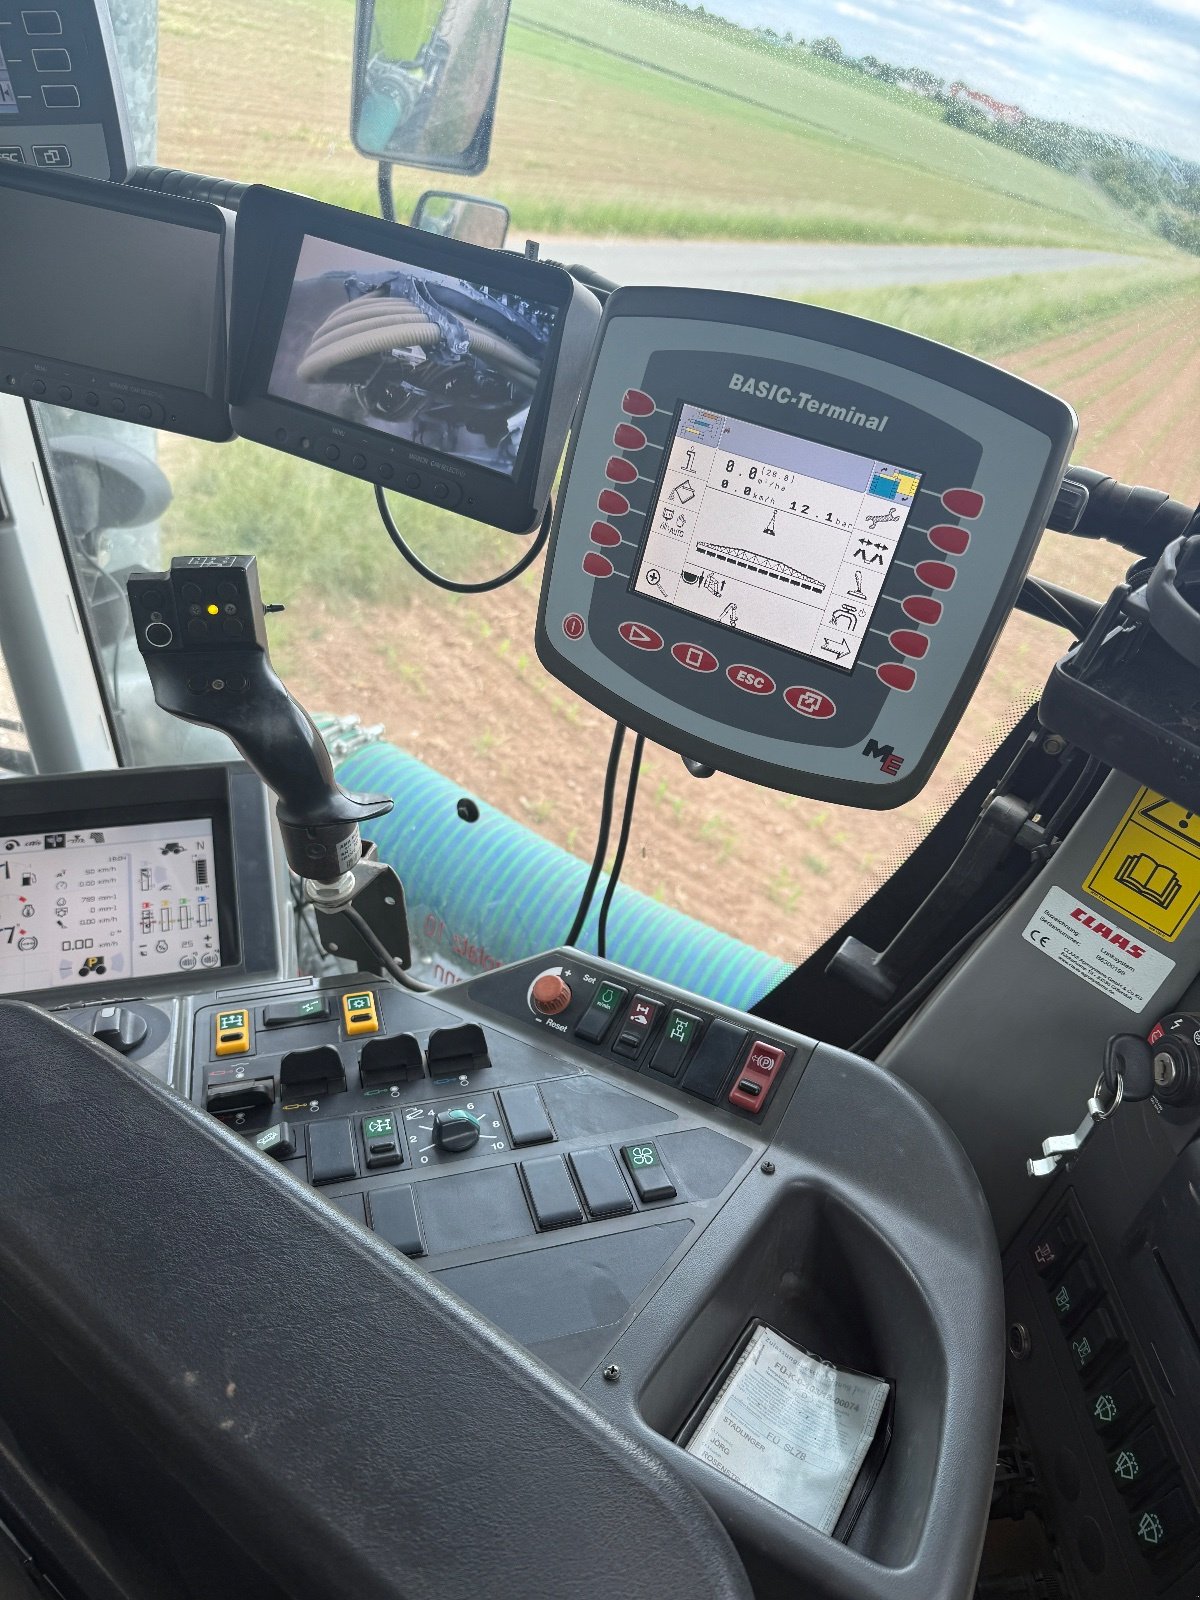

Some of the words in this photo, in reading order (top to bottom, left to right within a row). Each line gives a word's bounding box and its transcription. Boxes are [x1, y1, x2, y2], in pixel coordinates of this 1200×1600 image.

[0, 152, 18, 162] SC
[728, 373, 888, 432] BASIC-Terminal
[789, 501, 833, 522] 12.1
[835, 517, 852, 529] bar
[736, 670, 764, 688] ESC
[1030, 930, 1050, 948] CE
[1070, 908, 1146, 958] CLAAS
[62, 938, 94, 951] 0.00
[582, 974, 597, 984] Set
[546, 1018, 568, 1032] Reset
[466, 1102, 474, 1110] 6
[492, 1120, 500, 1128] 8
[490, 1142, 504, 1150] 10
[420, 1156, 428, 1164] 0
[723, 1416, 766, 1452] STADLINGER
